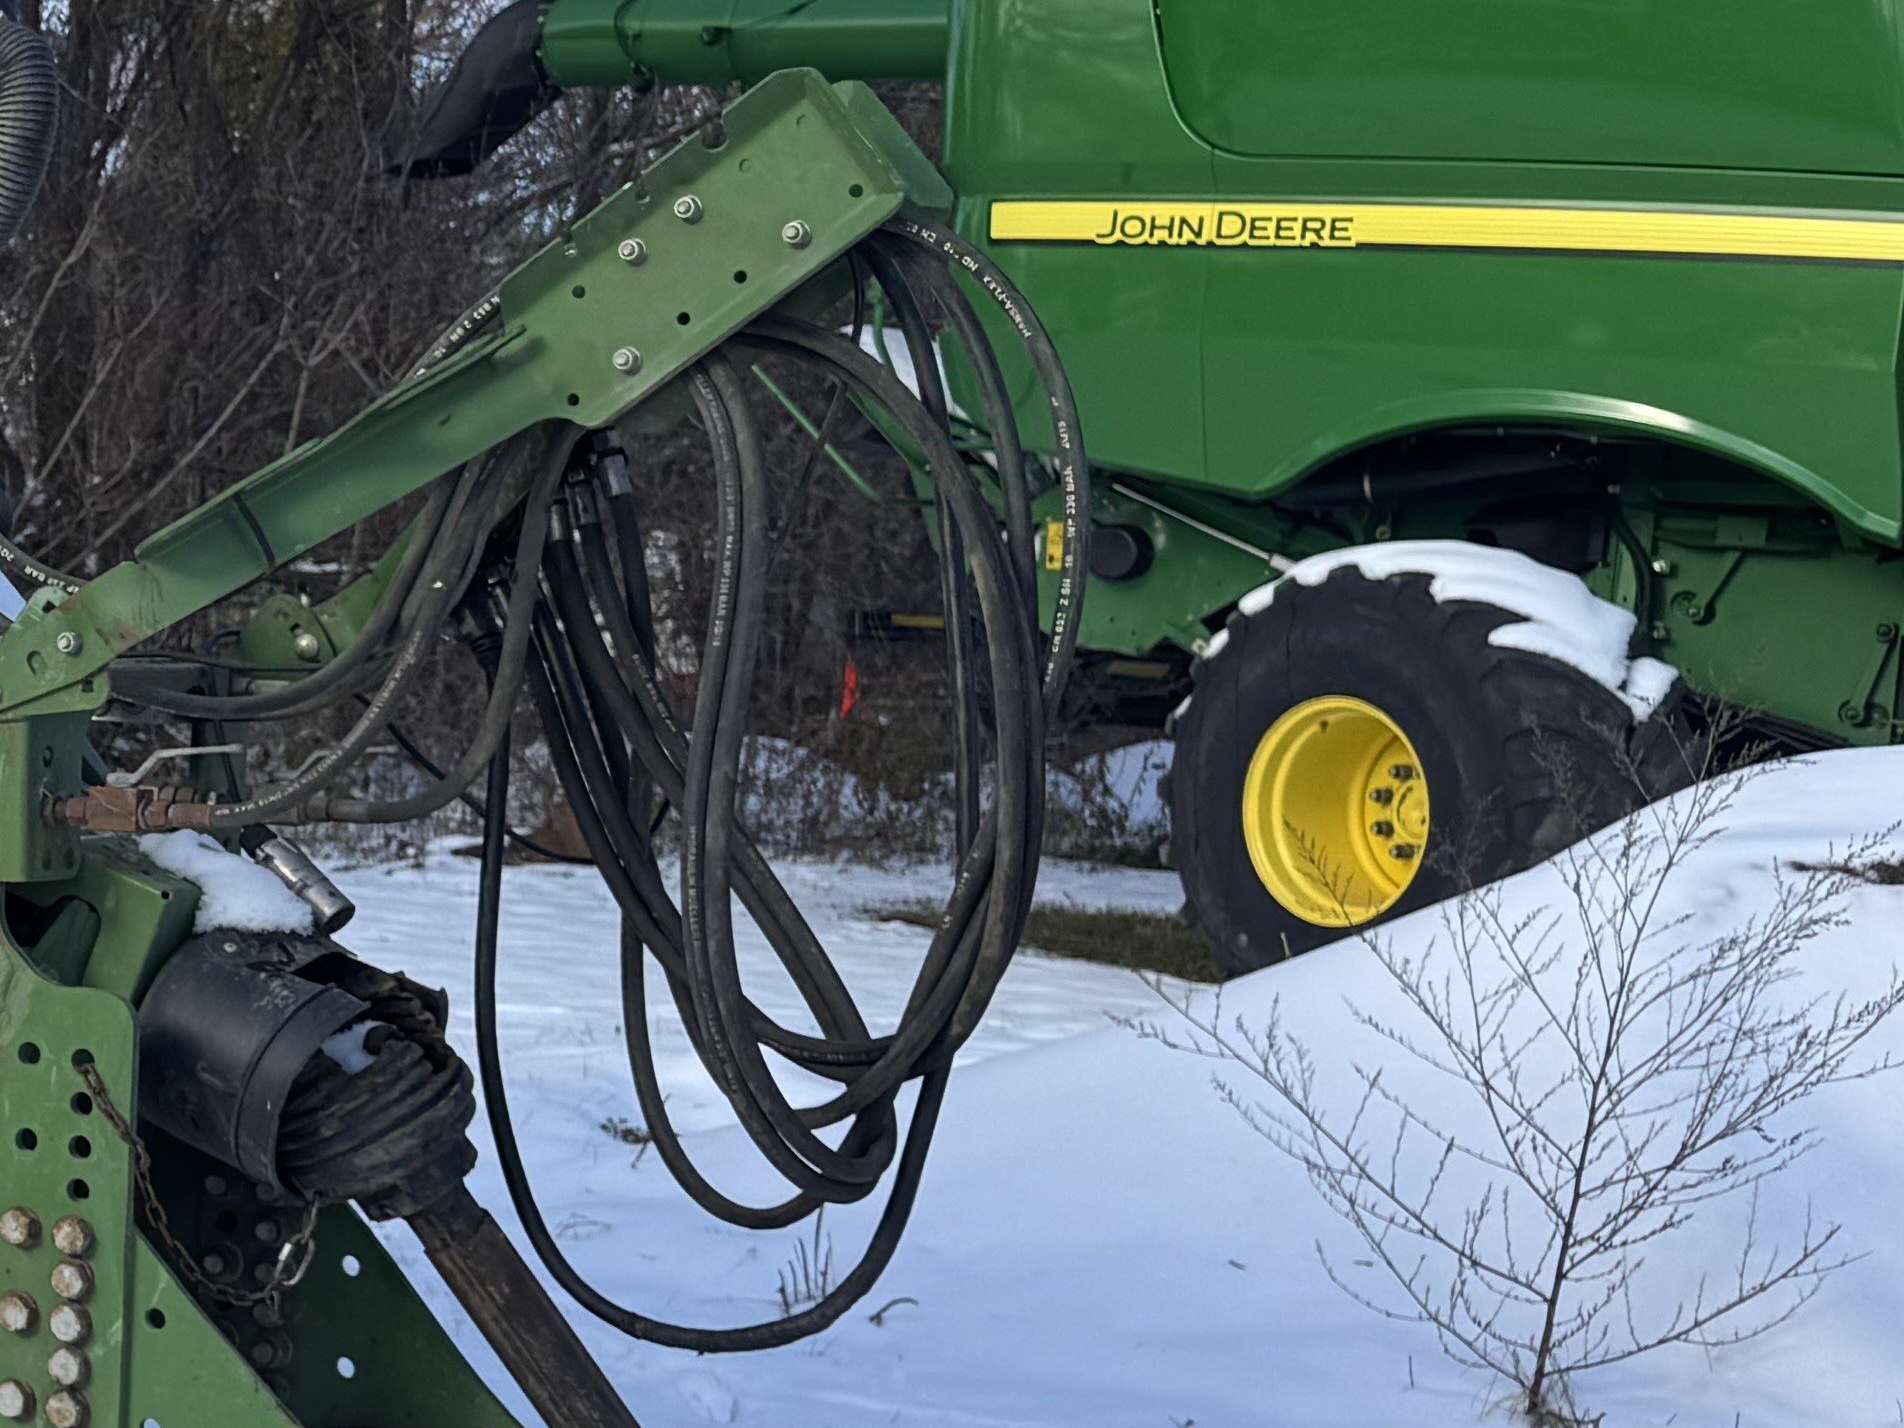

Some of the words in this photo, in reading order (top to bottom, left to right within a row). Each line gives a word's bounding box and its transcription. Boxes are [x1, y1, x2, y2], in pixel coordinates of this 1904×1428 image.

[1095, 209, 1204, 239] JOHN
[1215, 211, 1354, 241] DEERE
[24, 565, 46, 582] BAR
